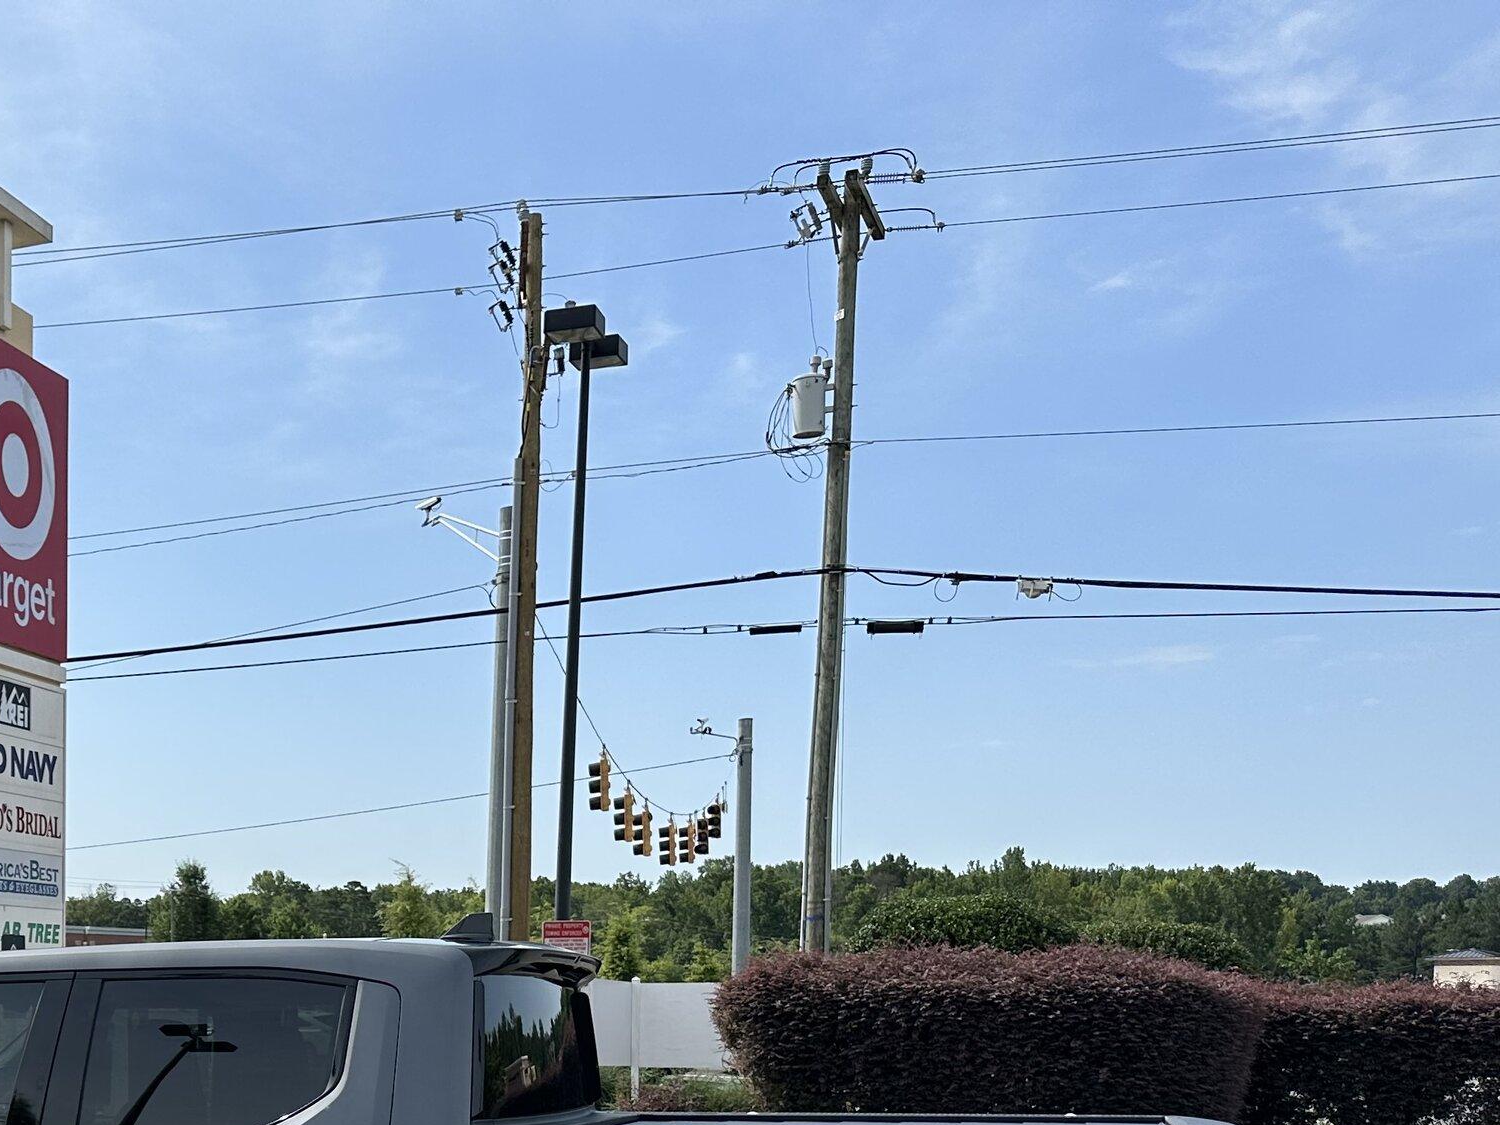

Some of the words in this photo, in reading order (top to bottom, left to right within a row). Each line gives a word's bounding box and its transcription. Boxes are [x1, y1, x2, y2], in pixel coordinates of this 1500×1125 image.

[8, 703, 29, 728] REI
[10, 745, 58, 785] NAVY
[15, 806, 62, 839] BRIDAL
[30, 860, 59, 883] BEST
[16, 883, 58, 896] EYEGLASSES
[27, 922, 60, 944] TREE
